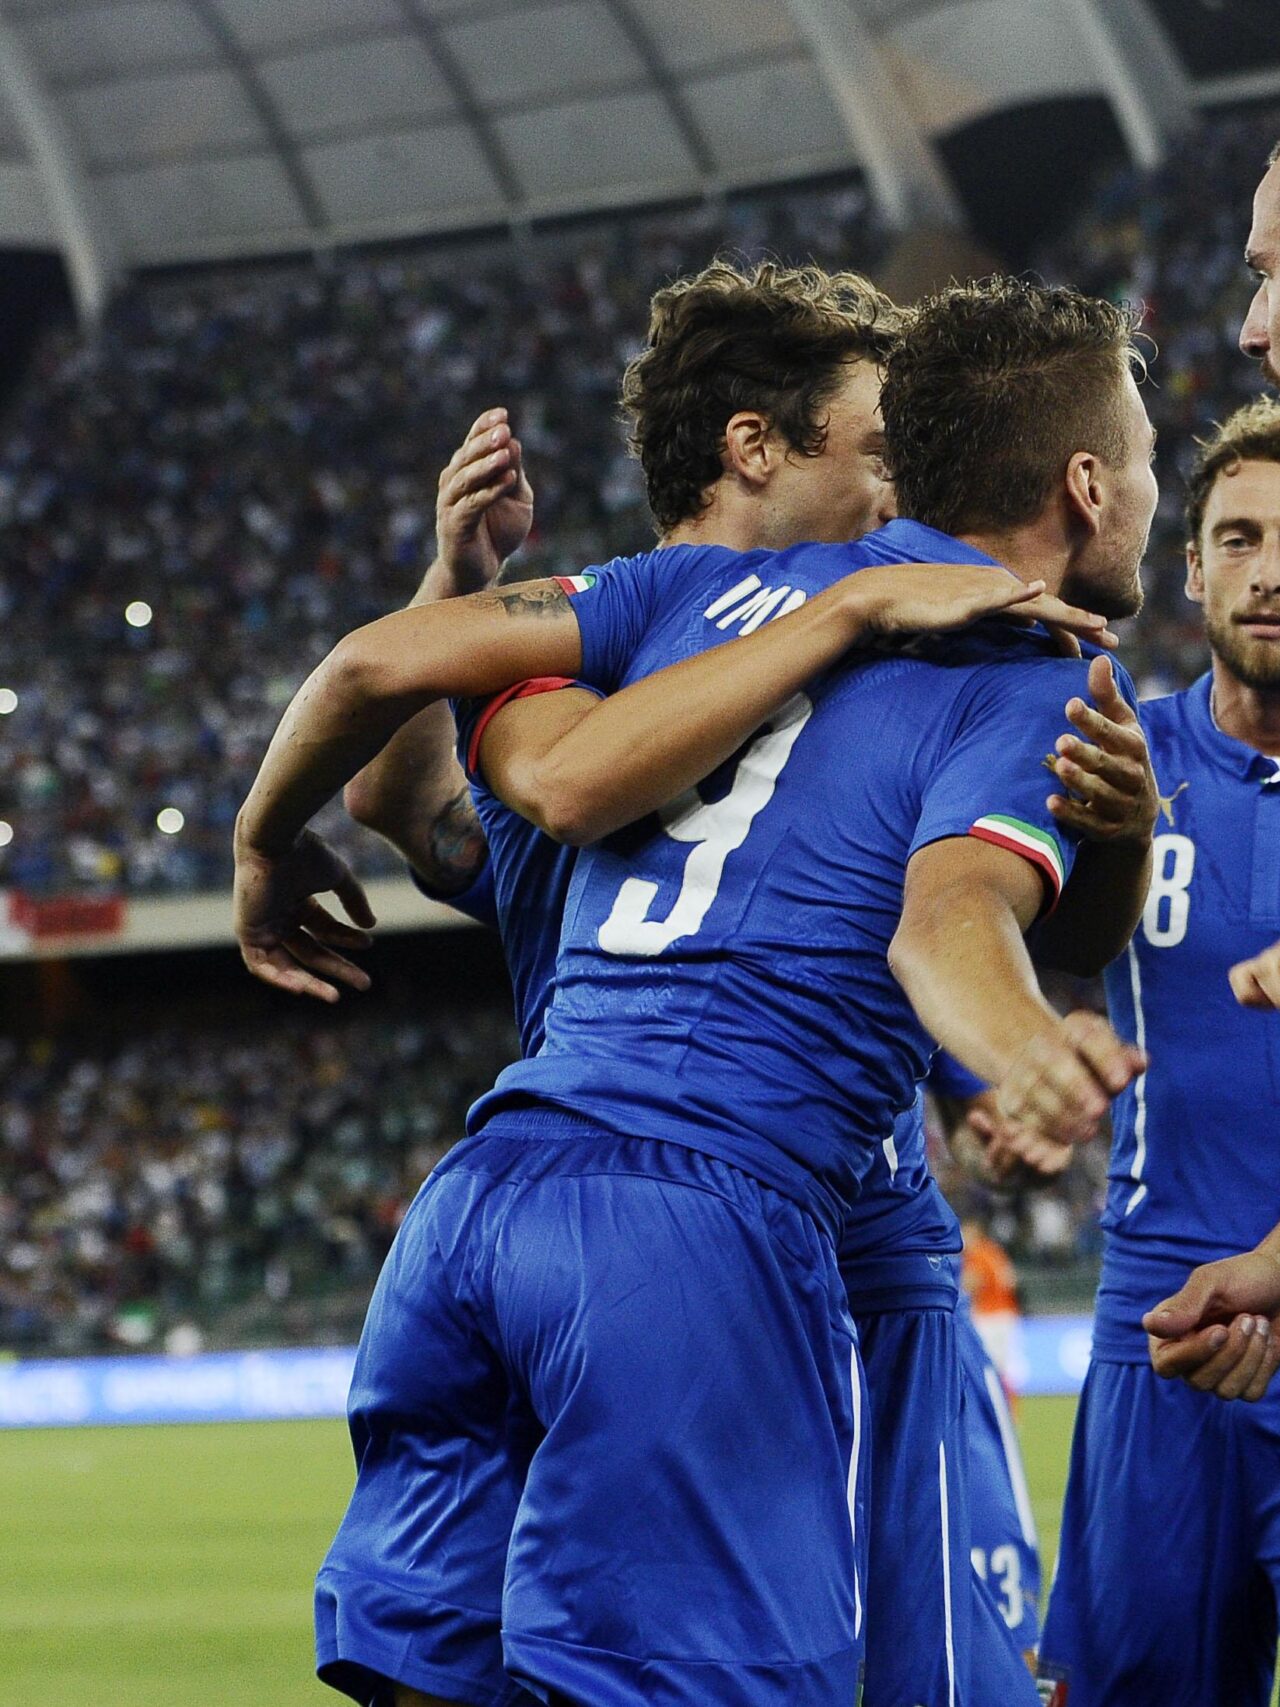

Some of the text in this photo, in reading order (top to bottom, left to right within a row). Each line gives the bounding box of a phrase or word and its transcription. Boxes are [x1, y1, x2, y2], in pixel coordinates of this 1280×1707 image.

[703, 574, 807, 637] IM
[598, 691, 813, 956] 9
[1143, 833, 1196, 948] 8
